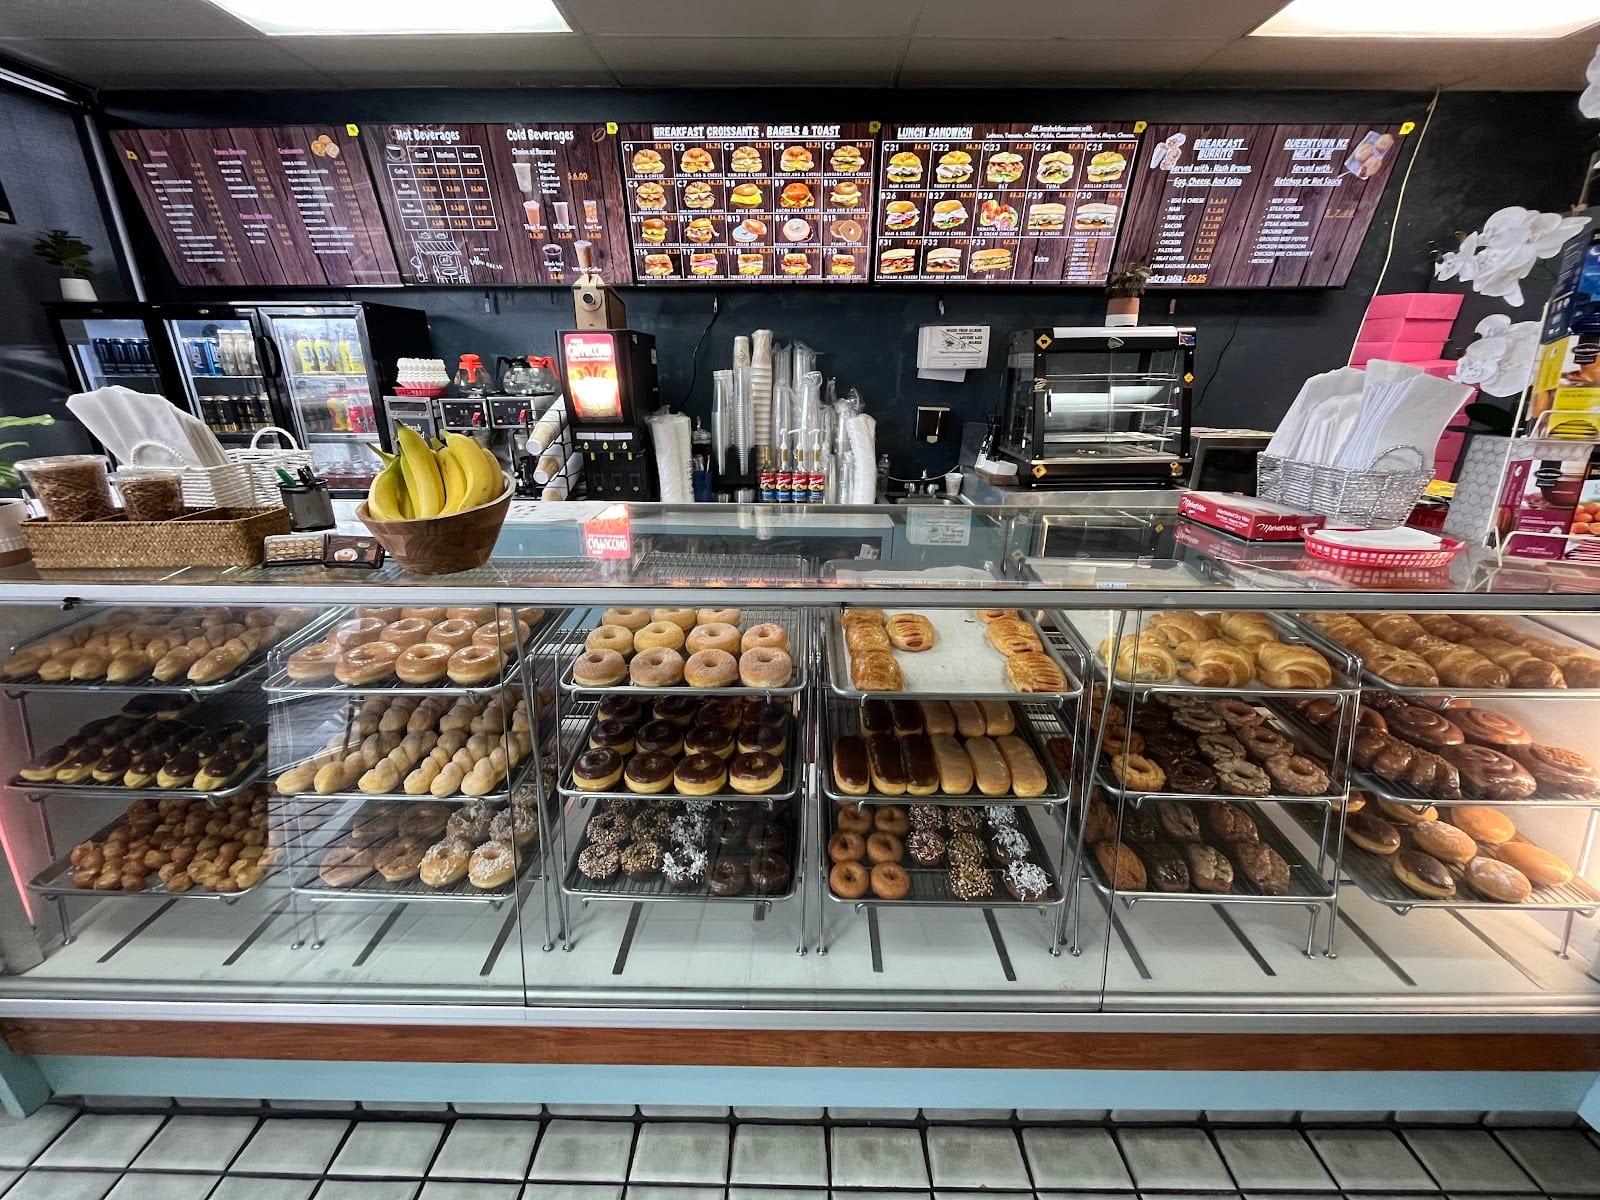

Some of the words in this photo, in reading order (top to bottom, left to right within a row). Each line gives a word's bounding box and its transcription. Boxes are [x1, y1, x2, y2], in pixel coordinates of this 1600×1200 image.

[654, 126, 704, 137] BREAKFAST
[706, 126, 758, 137] CROISSANTS
[766, 126, 800, 137] BAGELS
[802, 126, 809, 137] &
[812, 126, 840, 137] TOAST
[898, 127, 926, 138] LUNCH
[928, 127, 972, 138] SANDWICH
[395, 129, 414, 144] Hot
[414, 129, 460, 144] Beverages
[507, 129, 526, 144] Cold
[528, 129, 574, 144] Beverages
[825, 142, 836, 150] C5
[1194, 139, 1244, 149] BREAKFAST
[1285, 139, 1334, 148] QUEENTOWN
[1199, 150, 1234, 159] BURRITO
[1292, 150, 1317, 159] MEAT
[1319, 150, 1334, 159] PIE
[1292, 164, 1314, 172] Served
[1276, 178, 1301, 186] Ketchup
[879, 238, 892, 246] F31
[923, 238, 938, 246] F32
[1187, 274, 1207, 283] $0.25
